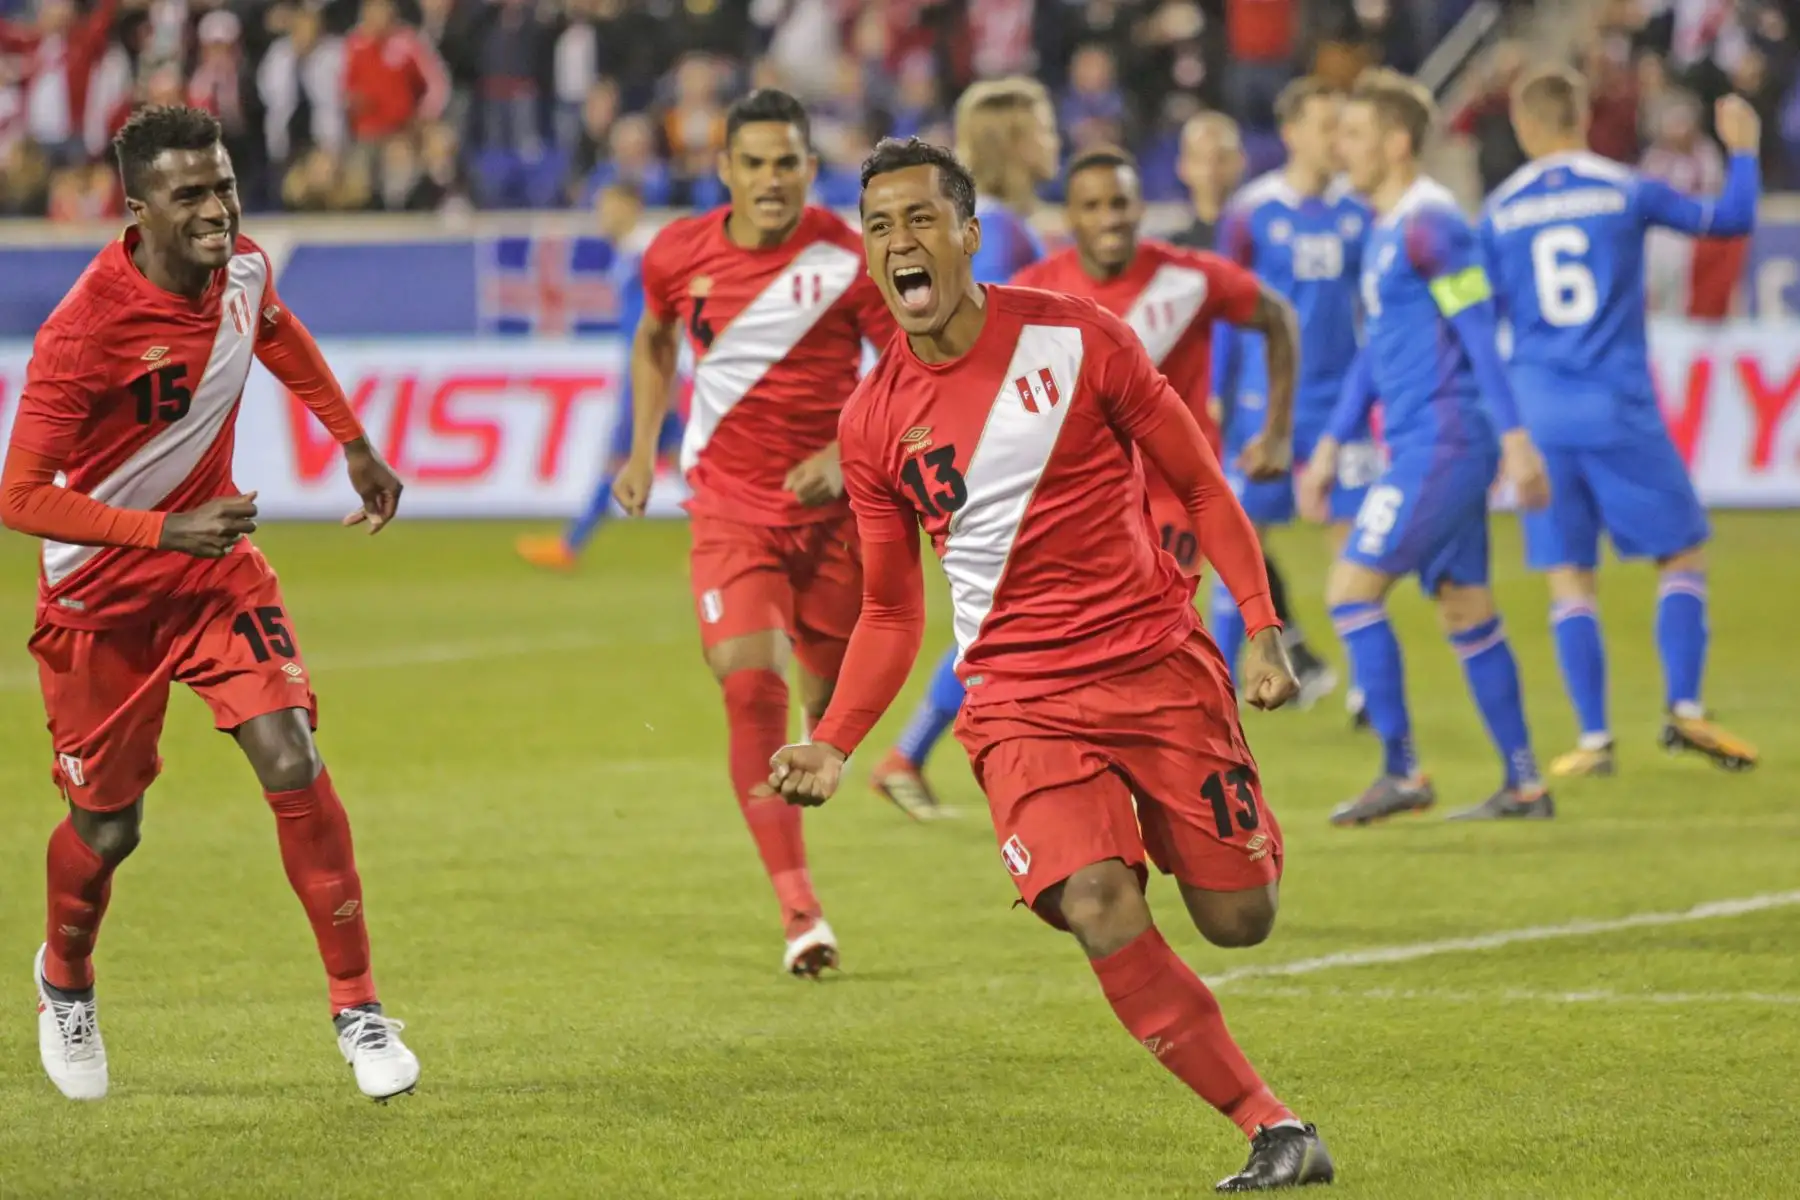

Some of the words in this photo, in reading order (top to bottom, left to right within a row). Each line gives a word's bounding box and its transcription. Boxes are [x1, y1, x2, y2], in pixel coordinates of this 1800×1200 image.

[1532, 225, 1597, 326] 6
[131, 364, 191, 424] 15
[906, 438, 933, 454] umbro
[901, 444, 968, 517] 13
[1161, 524, 1198, 568] 10
[232, 606, 296, 663] 15
[1200, 764, 1260, 838] 13
